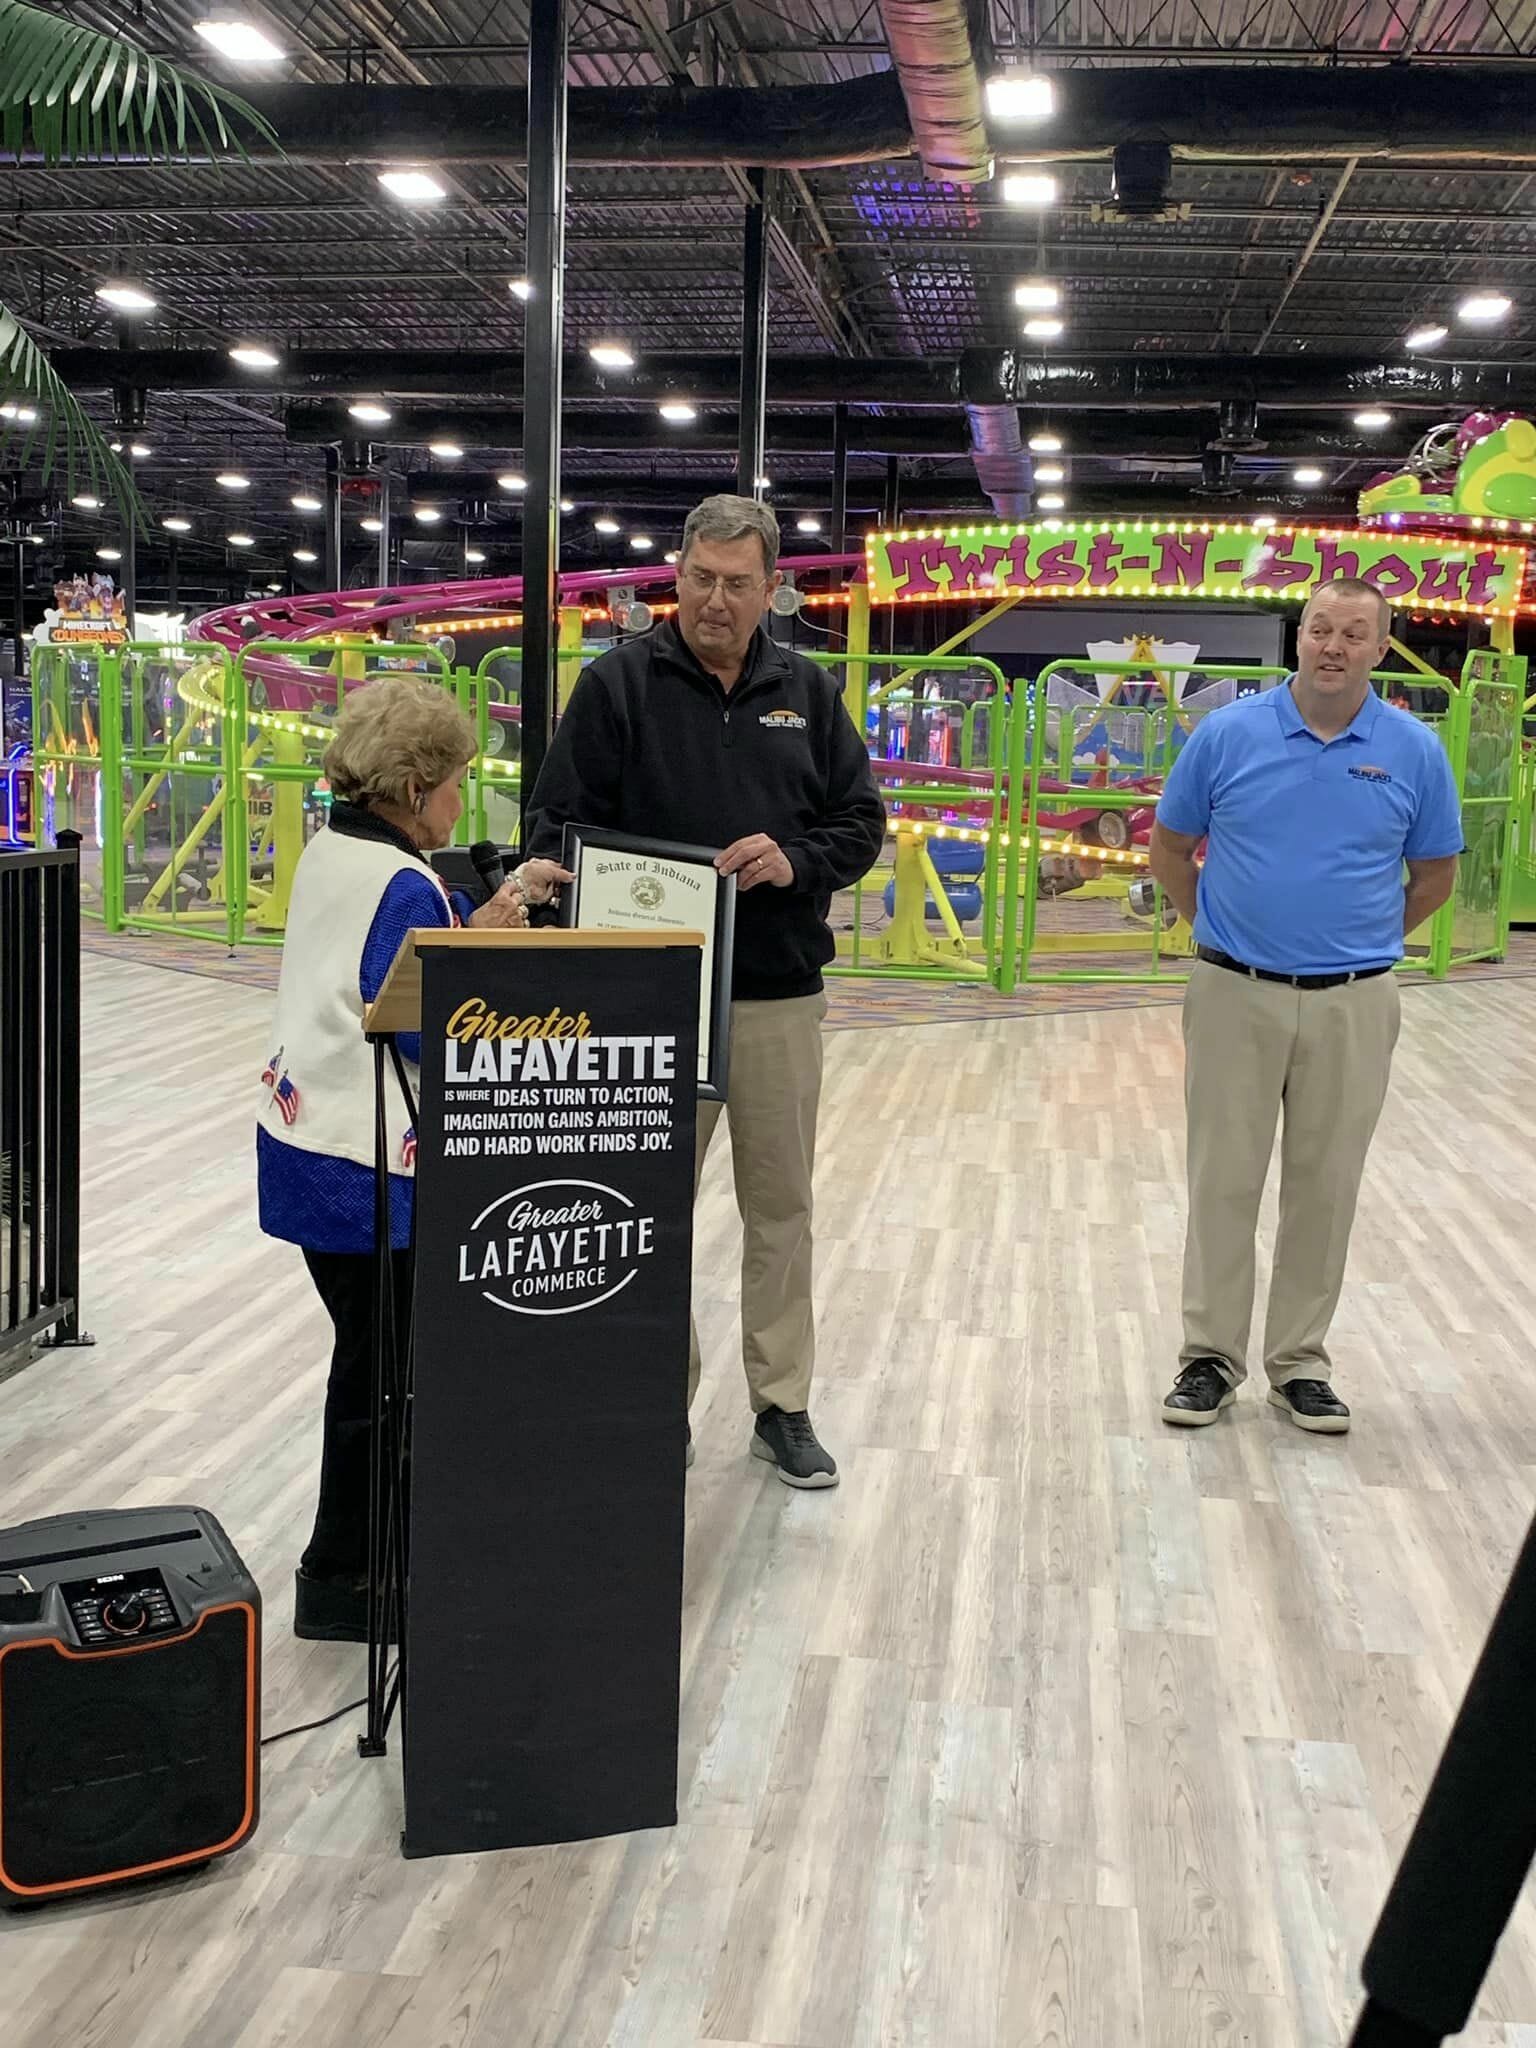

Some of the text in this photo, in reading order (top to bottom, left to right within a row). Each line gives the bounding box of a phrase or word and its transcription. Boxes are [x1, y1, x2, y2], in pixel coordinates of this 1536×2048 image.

[885, 530, 1504, 605] Twist-N-Shout
[53, 629, 125, 644] DUNGEONS
[595, 859, 701, 892] State of Indiana
[446, 997, 592, 1044] Greater
[445, 1035, 676, 1083] LAFAYETTE
[445, 1085, 674, 1107] IS WHERE IDEAS TURN TO ACTION,
[444, 1109, 673, 1131] IMAGINATION GAINS AMBITION,
[443, 1131, 673, 1157] AND HARD WORK FINDS JOY.
[507, 1199, 604, 1232] Greater
[458, 1216, 655, 1283] LAFAYETTE
[511, 1266, 607, 1298] COMMERCE
